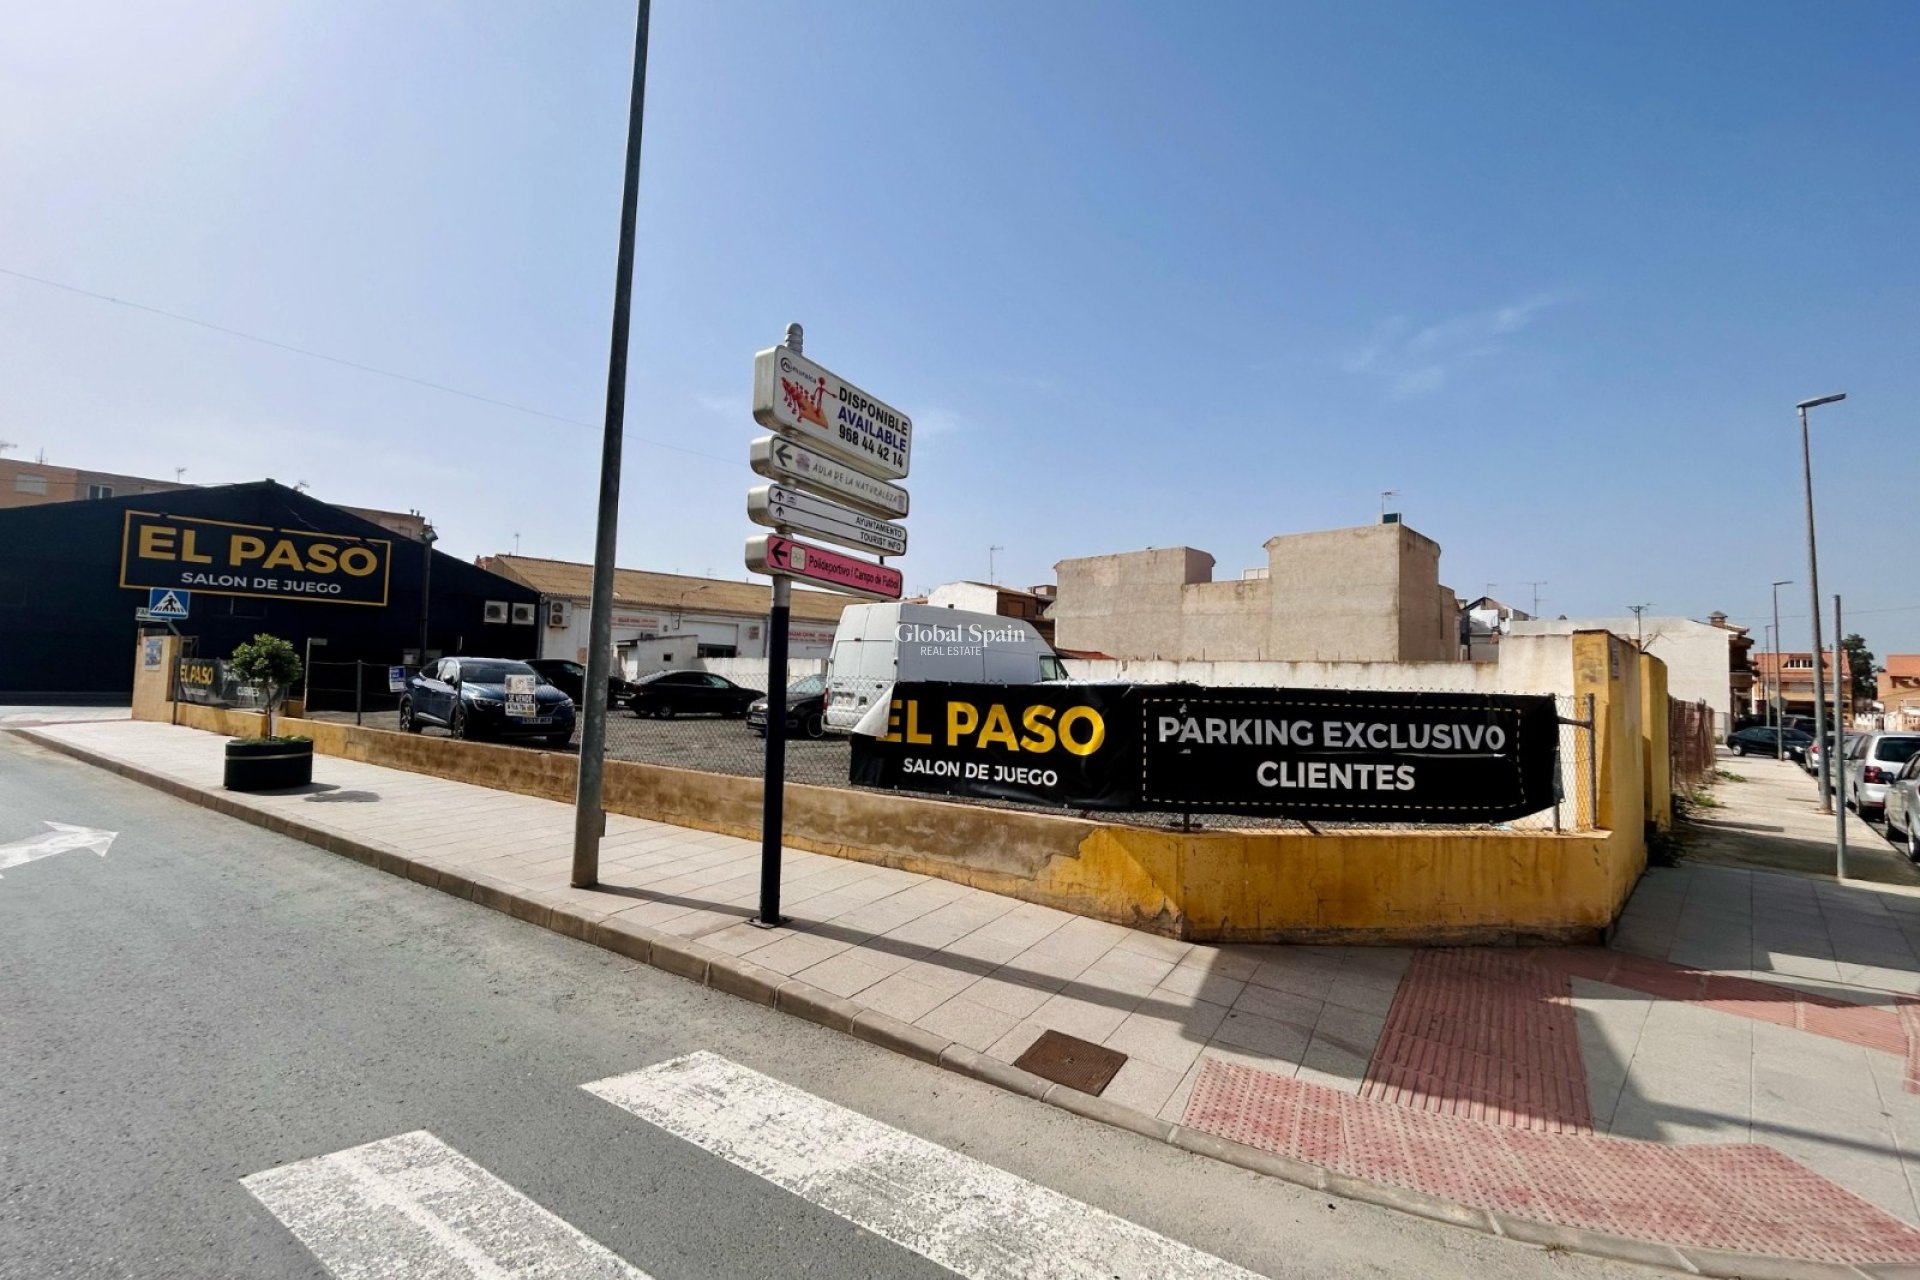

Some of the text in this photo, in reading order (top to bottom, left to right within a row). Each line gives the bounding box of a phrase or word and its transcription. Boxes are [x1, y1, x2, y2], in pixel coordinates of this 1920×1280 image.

[839, 386, 908, 436] DISPONIBLE
[838, 406, 907, 453] AVAILABLE
[839, 424, 903, 468] 968 44 42 14
[812, 463, 898, 503] AULA DE LA NATURALEZA
[856, 516, 903, 538] AYUNTAMIENTO
[861, 532, 901, 551] TOURIST INFO
[138, 525, 378, 577] EL PASO
[181, 572, 342, 595] SALON DE JUEGO
[808, 555, 851, 579] Polideportivo
[854, 568, 875, 584] Campo
[875, 575, 882, 583] de
[190, 664, 214, 686] PASO
[947, 701, 1105, 756] PASO
[1158, 716, 1505, 750] PARKING EXCLUSIVO
[903, 758, 1058, 786] SALON DE JUEGO
[1256, 761, 1415, 791] CLIENTES
